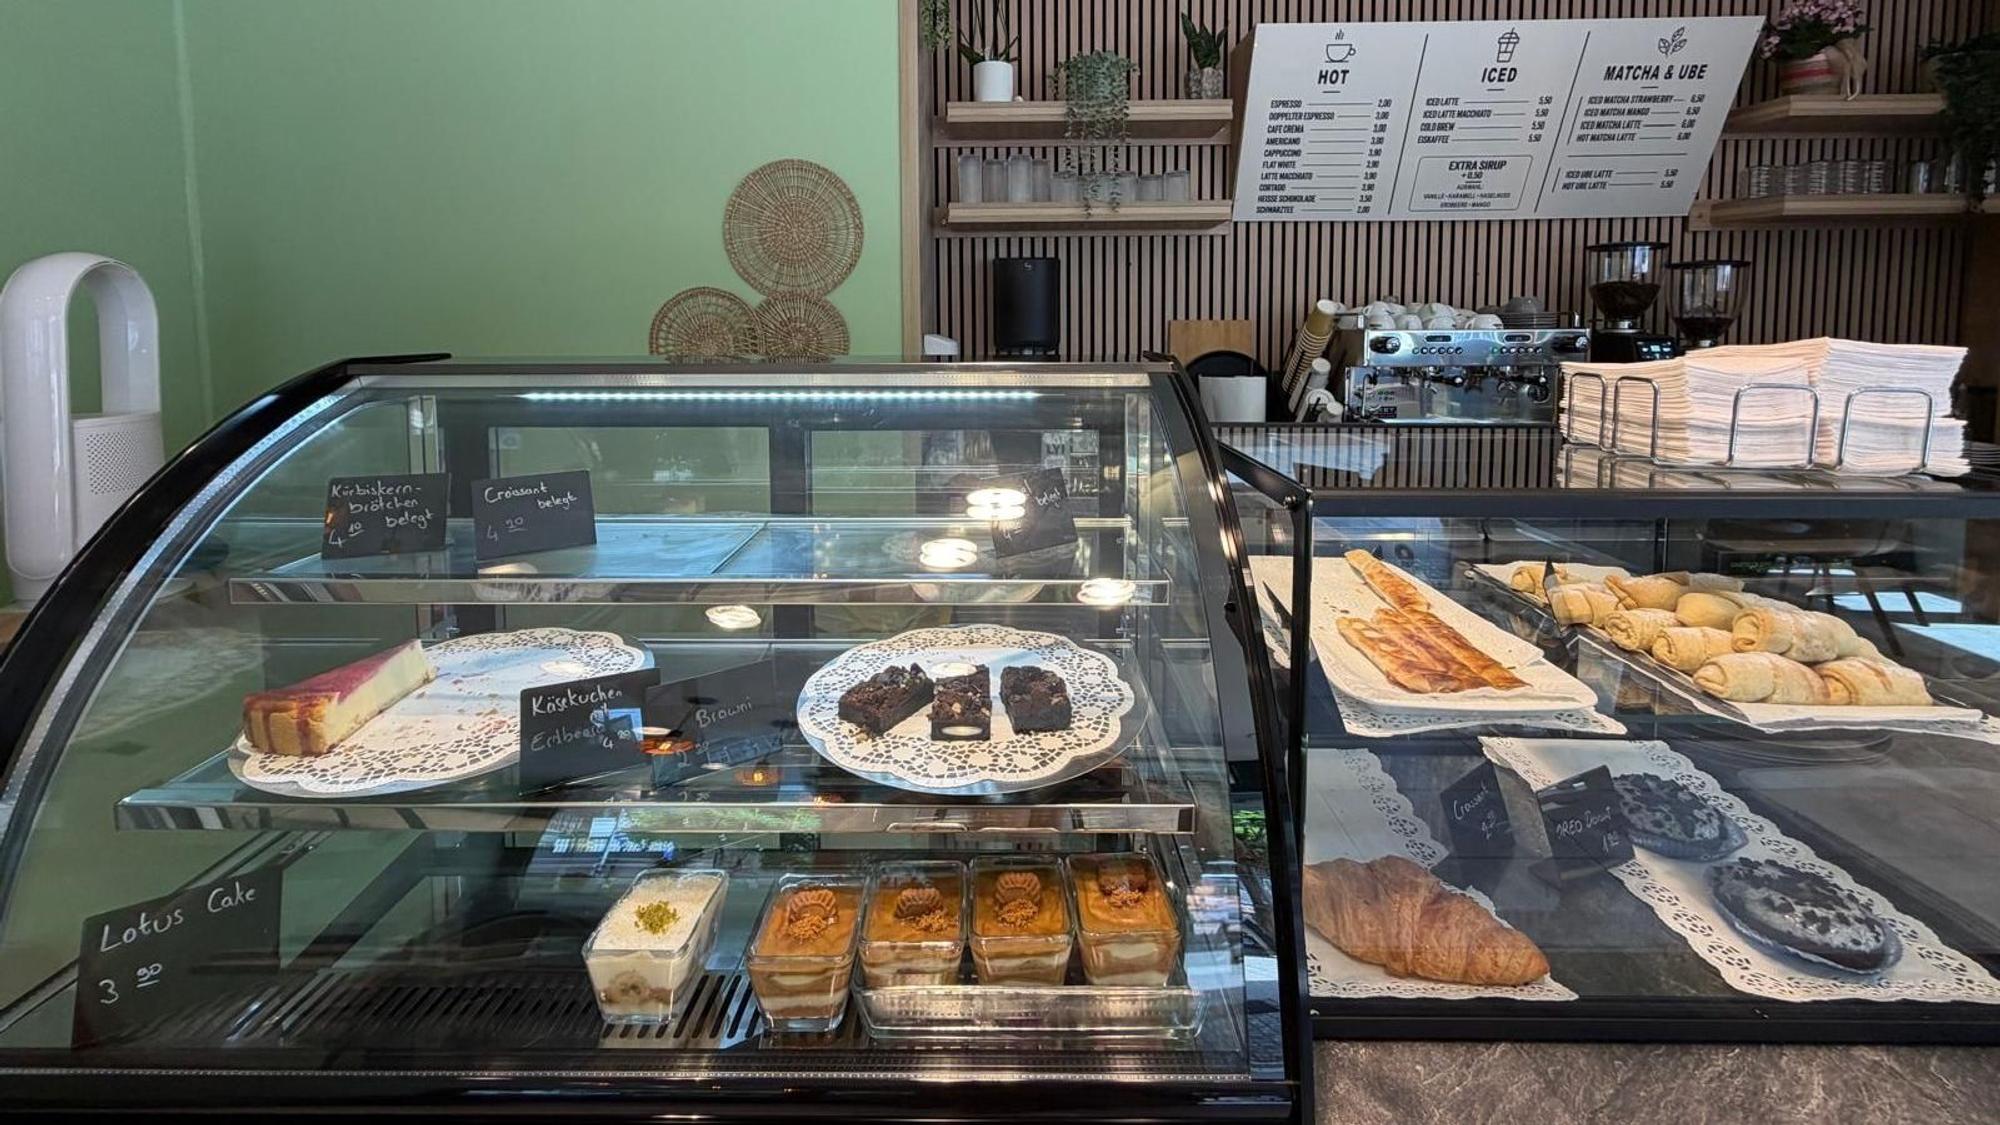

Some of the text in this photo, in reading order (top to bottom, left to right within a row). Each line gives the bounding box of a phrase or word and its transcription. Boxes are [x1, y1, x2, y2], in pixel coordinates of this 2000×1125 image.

[1318, 70, 1349, 84] HOT
[1481, 67, 1518, 83] ICED
[1603, 64, 1708, 81] MATCHA & UBE
[1271, 100, 1302, 109] ESPRESSO
[1426, 98, 1440, 106] ICED
[1440, 97, 1460, 106] LATTE
[1588, 96, 1604, 104] ICED
[1605, 96, 1628, 104] MATCHA
[1628, 95, 1674, 104] STRAWBERRY
[1269, 112, 1303, 120] DOPPELTER
[1304, 112, 1335, 120] ESPRESSO
[1423, 110, 1437, 119] ICED
[1437, 110, 1456, 118] LATTE
[1457, 110, 1492, 118] MACCHIATO
[1584, 108, 1600, 117] ICED
[1600, 108, 1625, 117] MATCHA
[1626, 107, 1650, 116] MANGO
[1283, 124, 1304, 133] CREMA
[1420, 123, 1436, 132] COLD
[1437, 122, 1455, 131] BREW
[1580, 121, 1596, 130] ICED
[1596, 121, 1621, 130] MATCHA
[1622, 120, 1642, 129] LATTE
[1266, 137, 1300, 145] AMERICANO
[1417, 135, 1450, 144] EISKAFFEE
[1576, 133, 1589, 142] HOT
[1590, 133, 1615, 142] MATCHA
[1616, 132, 1637, 141] LATTE
[1264, 149, 1302, 157] CAPPUCCINO
[1262, 161, 1277, 169] FLAT
[1278, 161, 1296, 169] WHITE
[1448, 160, 1507, 171] EXTRA SIRUP
[1279, 172, 1313, 180] MACCHIATO
[1565, 170, 1580, 179] ICED
[1580, 170, 1593, 178] UBE
[1593, 169, 1613, 178] LATTE
[1259, 184, 1286, 192] CORTADO
[1562, 182, 1575, 190] HOT
[1575, 182, 1588, 190] UBE
[1588, 181, 1608, 190] LATTE
[1257, 195, 1278, 203] HEISSE
[1279, 195, 1316, 203] SCHOKOLADE
[1256, 206, 1294, 214] SCHWARZTEE
[349, 496, 419, 513] brötchen
[537, 491, 578, 510] belegt
[385, 508, 434, 529] belegt
[329, 528, 346, 548] 4
[532, 684, 623, 717] Käsekuchen
[696, 696, 752, 728] Browni
[603, 735, 615, 749] 4
[100, 881, 256, 952] Lotus Cake
[99, 979, 119, 1004] 3
